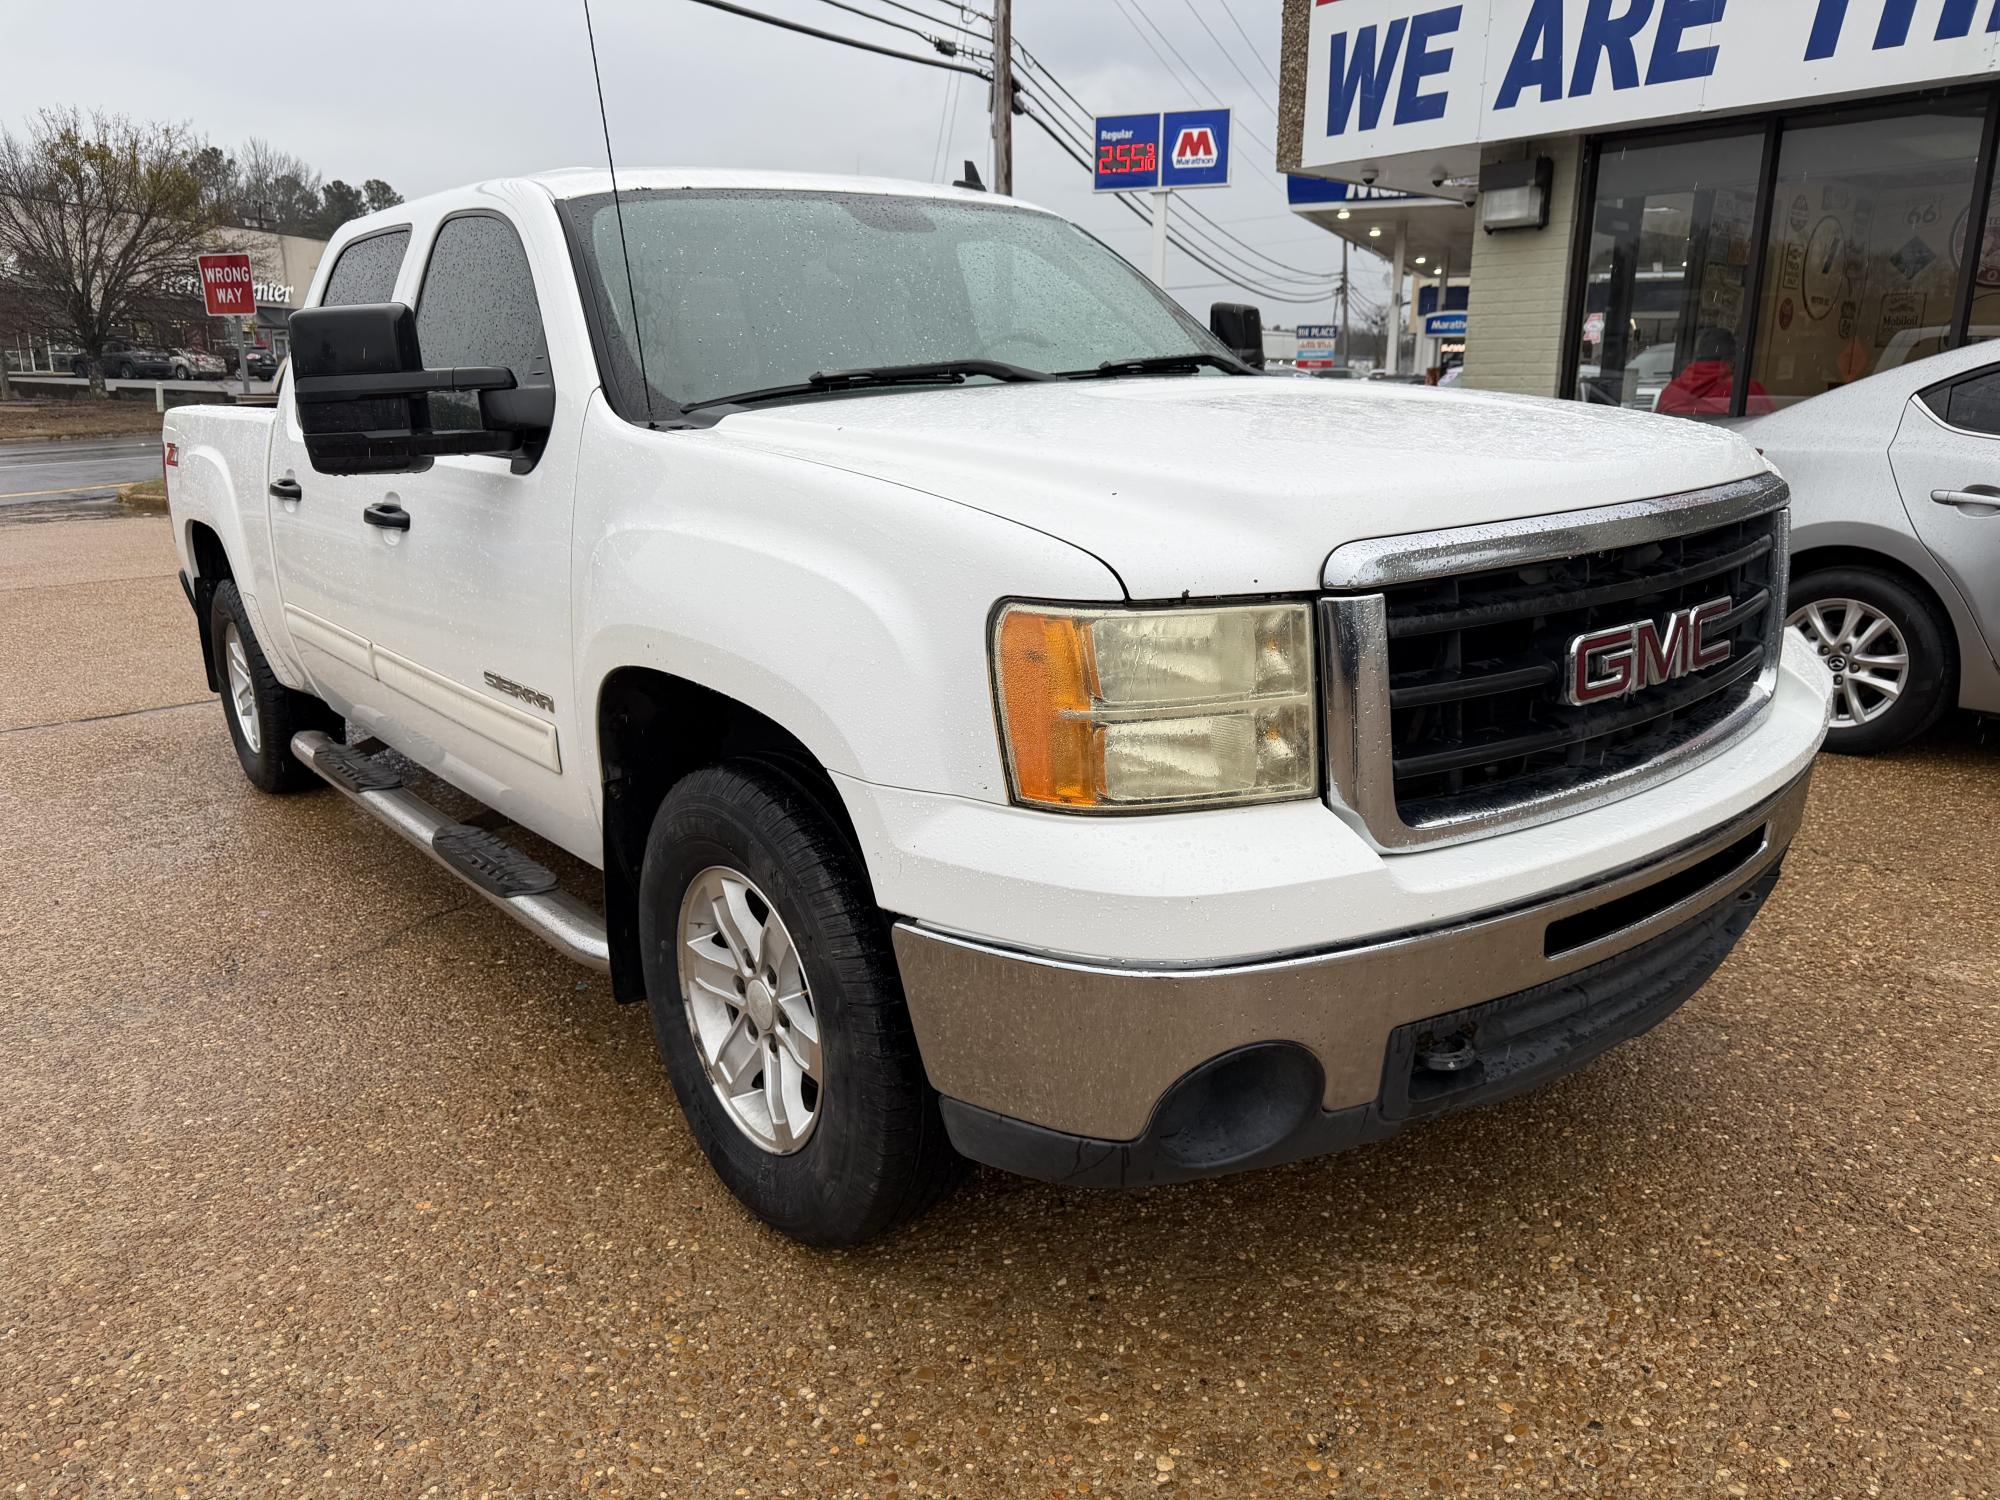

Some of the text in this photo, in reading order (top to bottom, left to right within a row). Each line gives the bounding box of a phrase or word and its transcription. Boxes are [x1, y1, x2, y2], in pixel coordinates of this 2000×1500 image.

[1327, 4, 1463, 137] WE
[1493, 0, 1728, 111] ARE
[1101, 129, 1134, 142] Regular
[1176, 157, 1214, 166] Marathon
[1907, 204, 1937, 224] 66
[205, 266, 250, 284] WRONG
[216, 288, 243, 304] WAY
[1569, 595, 1732, 706] GMC
[483, 670, 555, 714] SIERRA
